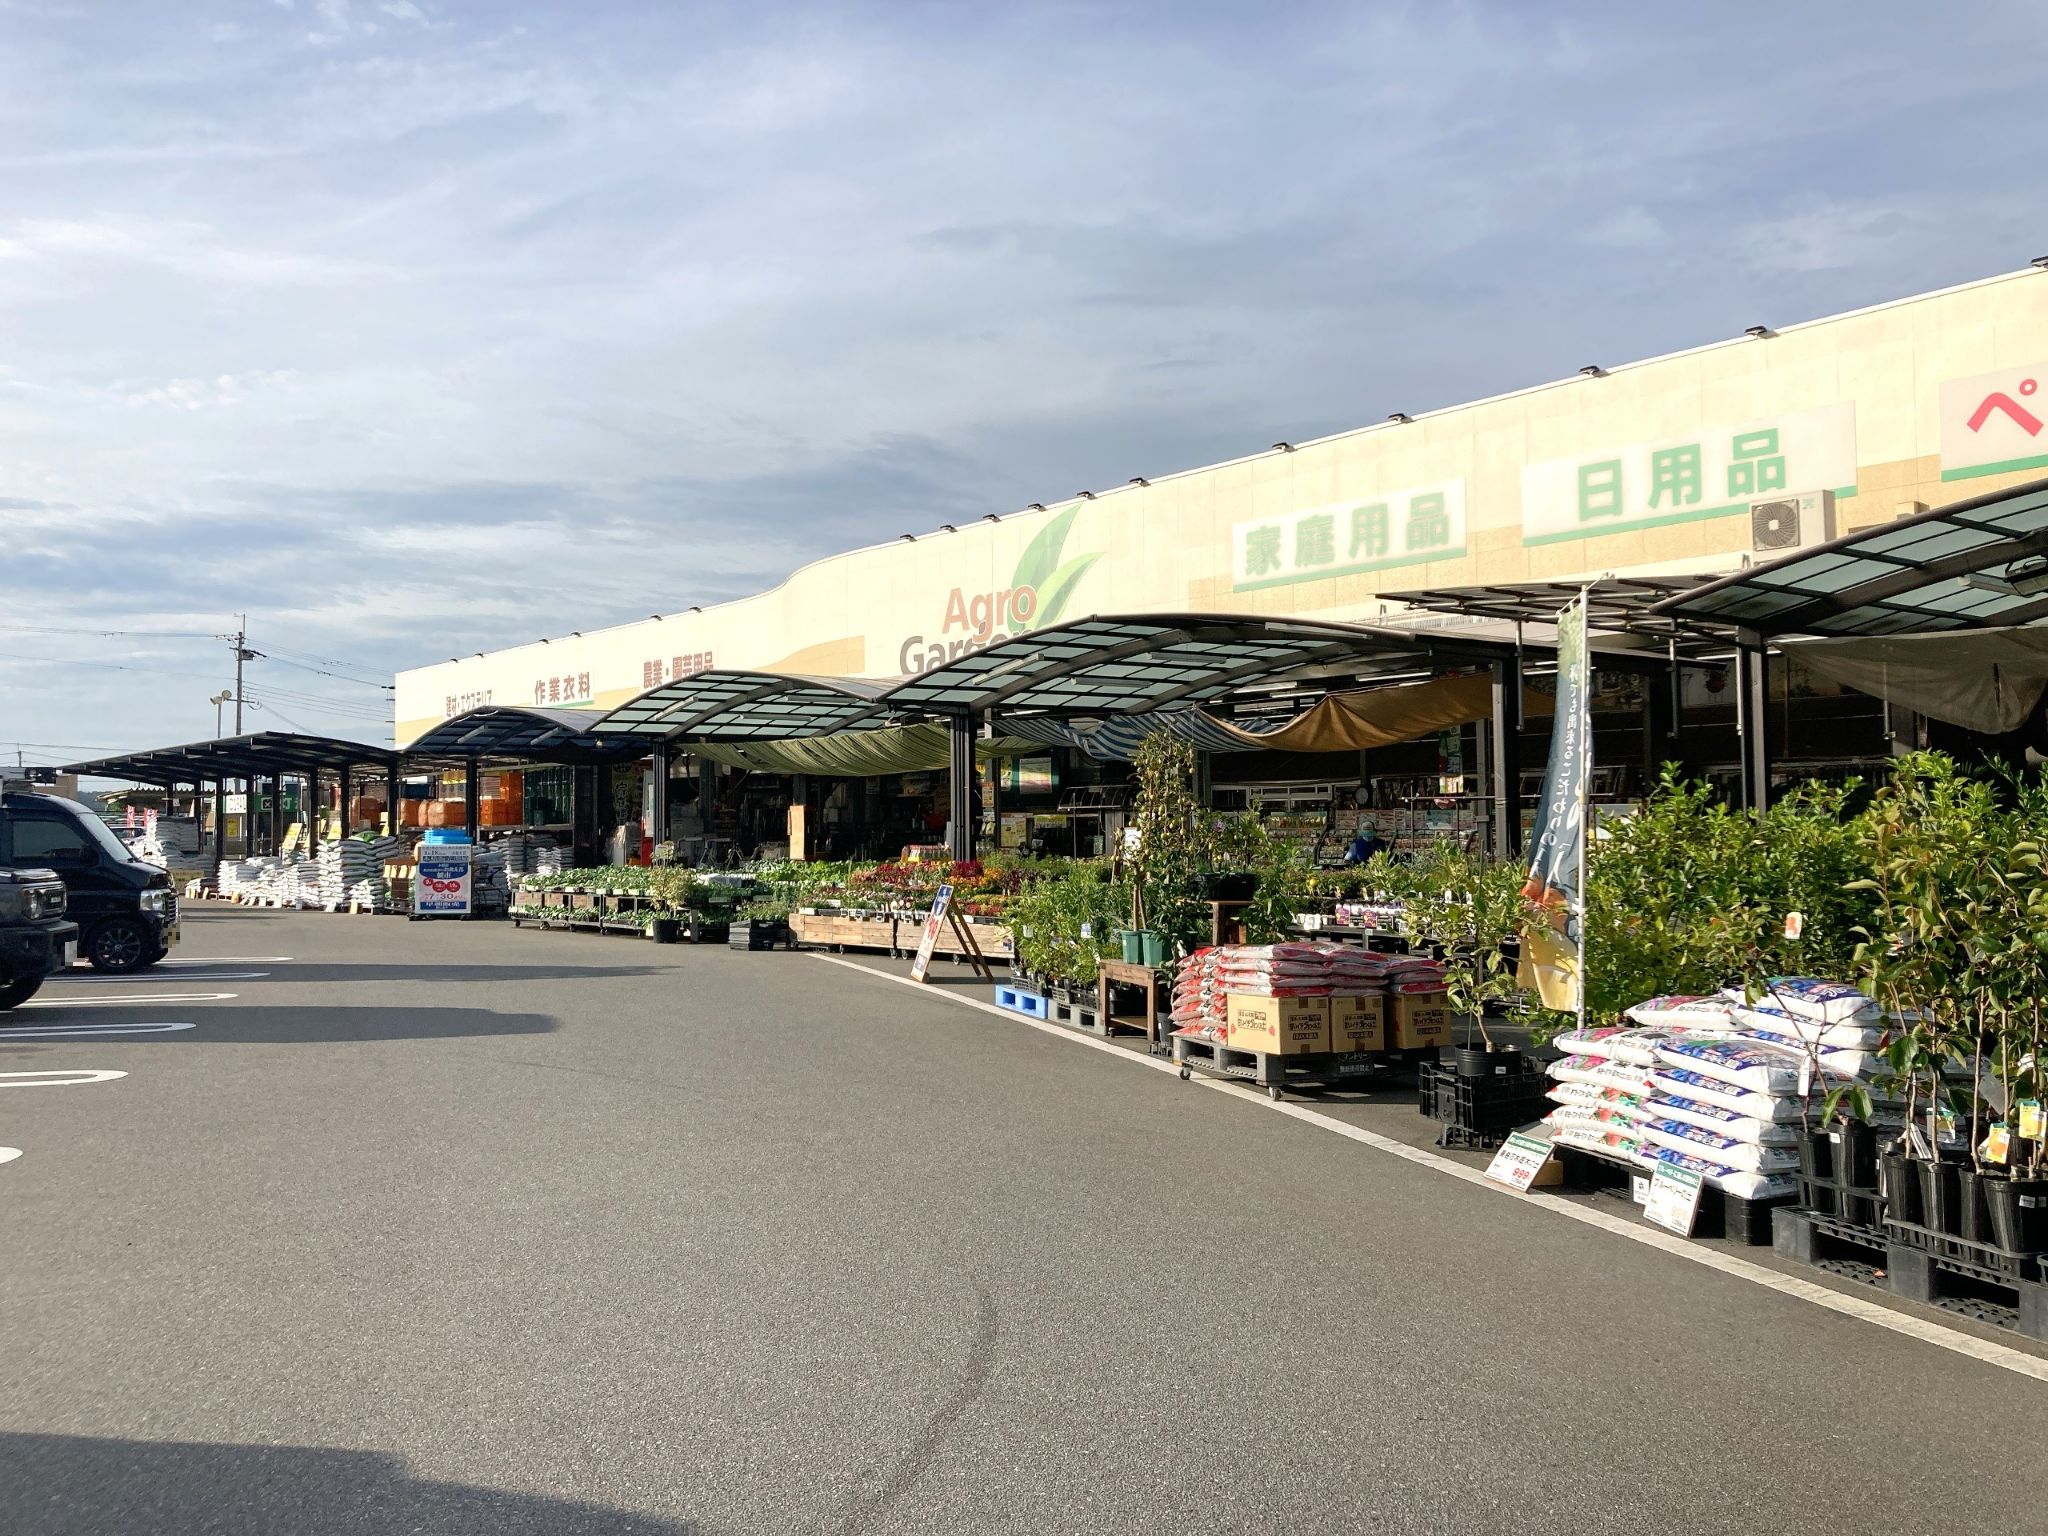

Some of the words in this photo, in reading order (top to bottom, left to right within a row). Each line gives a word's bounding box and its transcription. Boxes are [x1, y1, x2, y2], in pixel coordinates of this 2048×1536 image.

[1966, 379, 2044, 437] ペ
[1578, 428, 1786, 521] 日用品
[1245, 492, 1449, 575] 家庭用品
[942, 585, 1037, 643] Agro
[535, 672, 590, 705] 作業衣料
